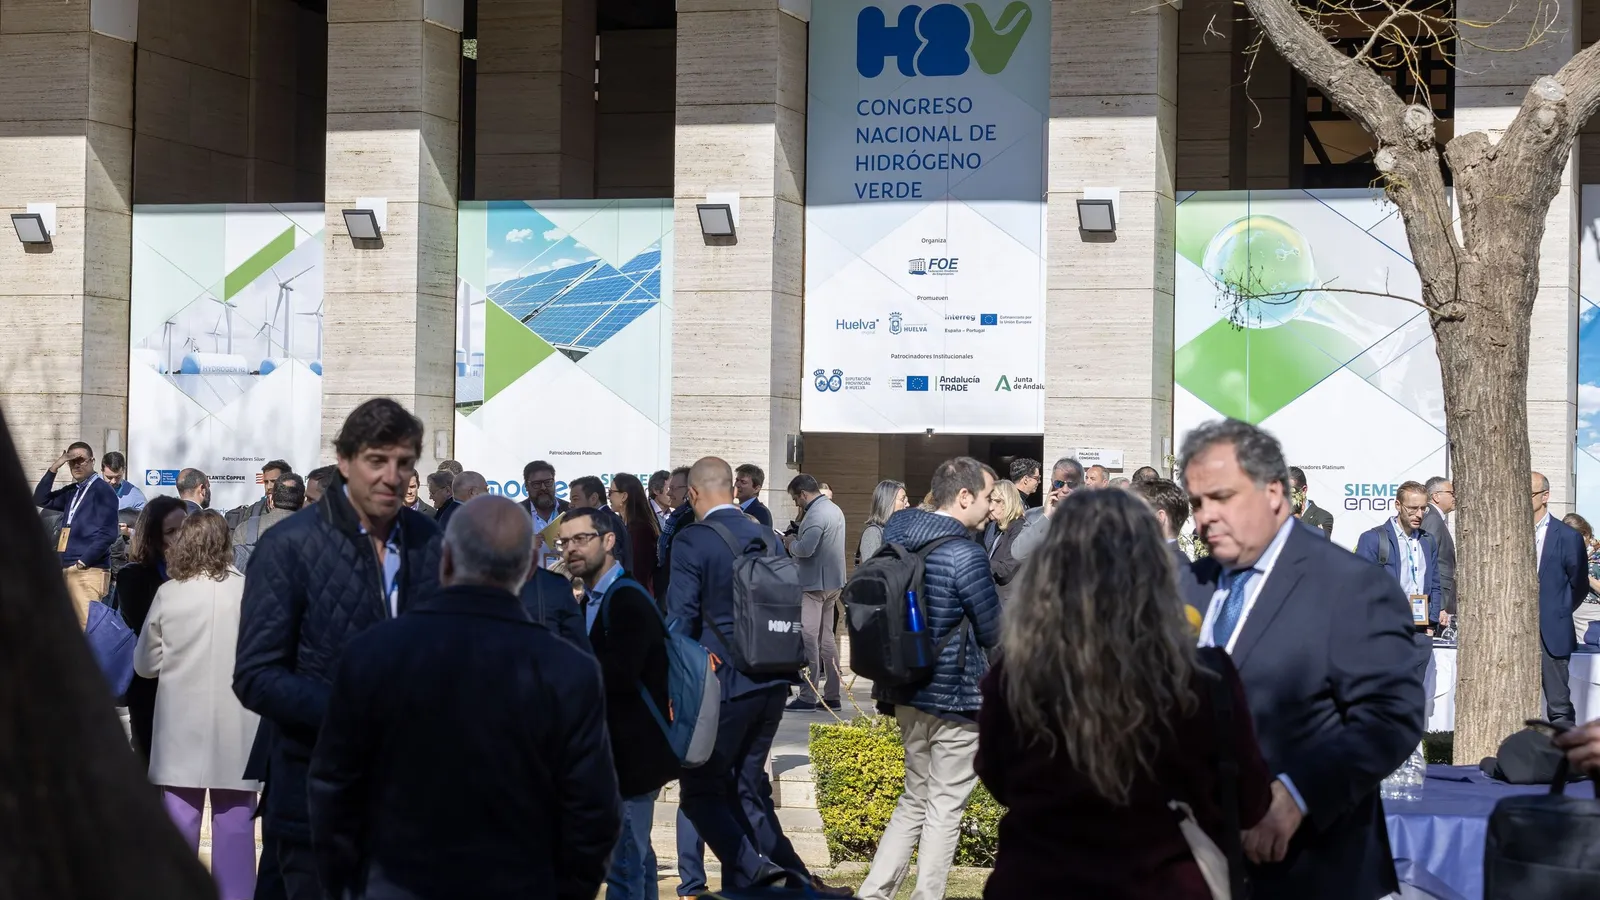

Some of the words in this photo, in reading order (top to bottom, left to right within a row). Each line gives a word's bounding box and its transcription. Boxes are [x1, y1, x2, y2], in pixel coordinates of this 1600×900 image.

[856, 97, 973, 116] CONGRESO
[856, 126, 963, 144] NACIONAL
[969, 124, 997, 141] DE
[855, 149, 982, 171] HIDRÓGENO
[854, 182, 923, 199] VERDE
[921, 237, 947, 245] Organiza
[928, 257, 959, 270] FOE
[836, 318, 876, 330] Huelva
[890, 352, 933, 360] Patrocinadores
[933, 352, 974, 360] Institucionales
[202, 365, 238, 373] HYDROGEN
[939, 375, 981, 384] Andalucía
[940, 384, 969, 392] TRADE
[1344, 483, 1398, 497] SIEME
[1344, 498, 1395, 511] ener
